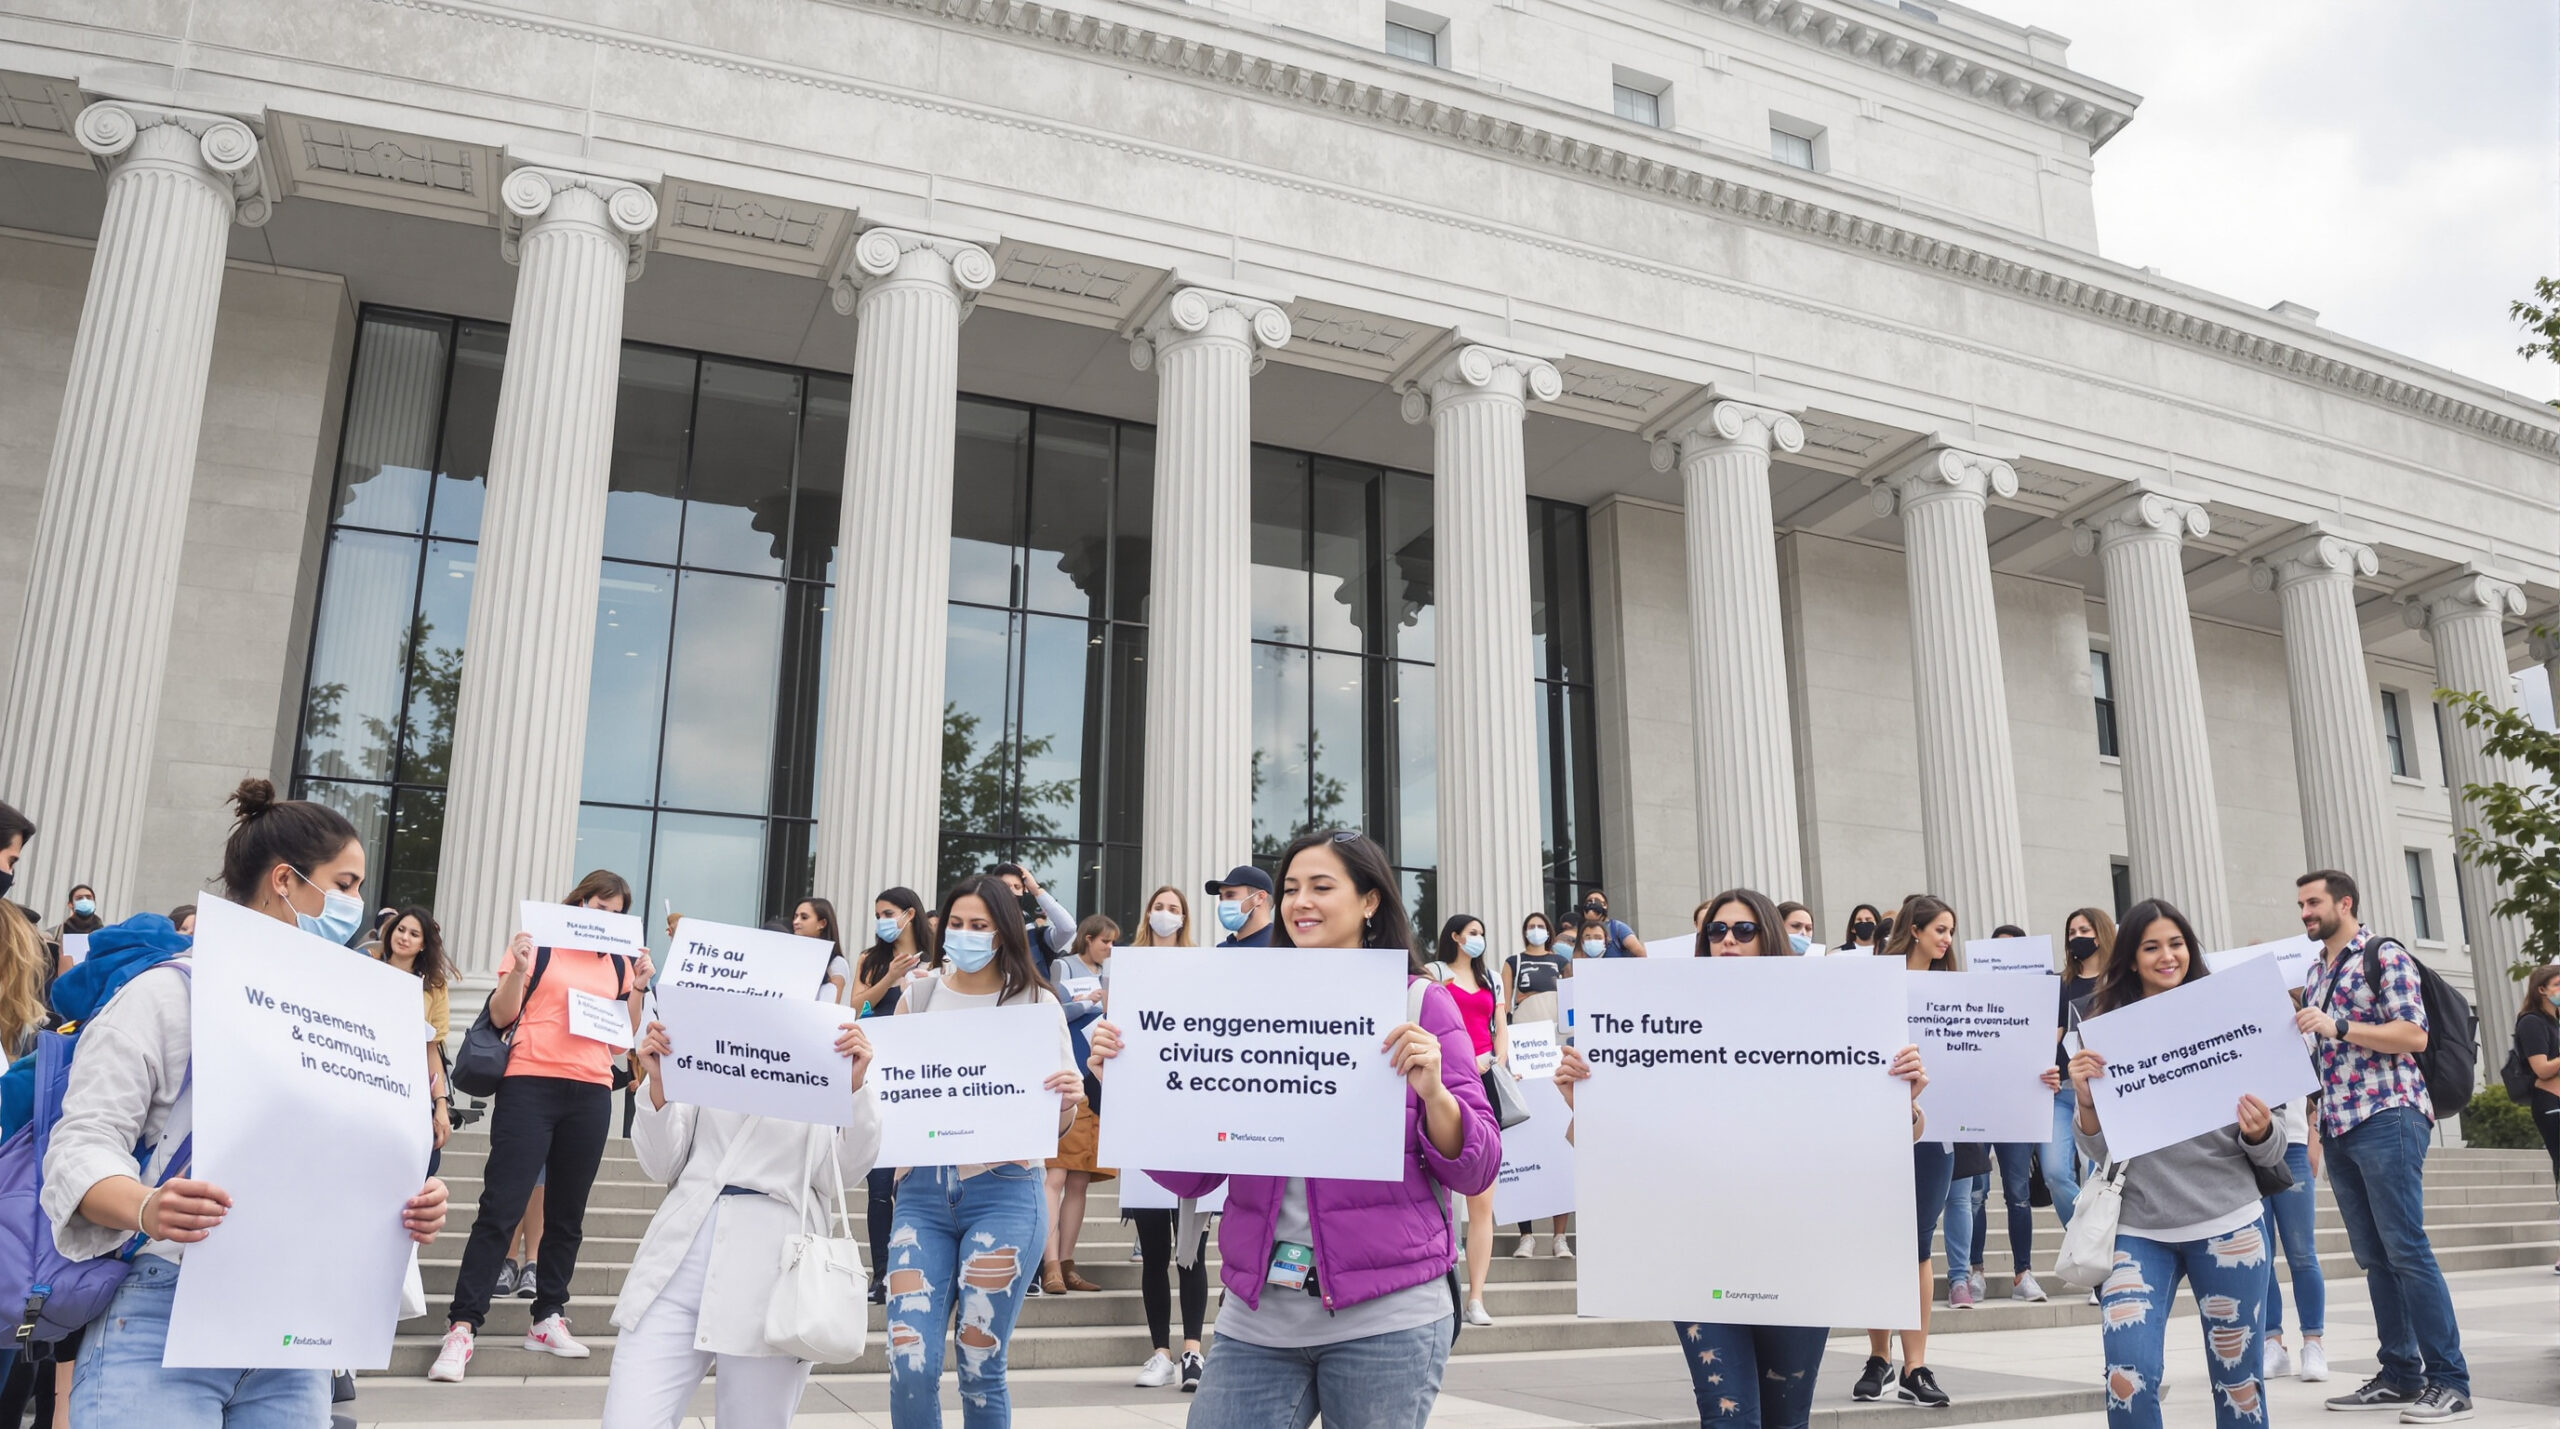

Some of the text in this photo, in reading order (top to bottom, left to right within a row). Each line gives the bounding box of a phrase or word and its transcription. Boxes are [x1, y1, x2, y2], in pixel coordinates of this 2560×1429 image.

[689, 942, 719, 958] This
[680, 959, 694, 972] is
[711, 966, 748, 980] your
[245, 986, 275, 1009] We
[1139, 1010, 1176, 1032] We
[1591, 1014, 1634, 1034] The
[292, 1025, 304, 1042] &
[301, 1052, 316, 1070] in
[1240, 1046, 1357, 1071] connique,
[1588, 1046, 1886, 1068] engagement ecvernomics.
[677, 1055, 693, 1069] of
[750, 1068, 829, 1087] ecmanics
[881, 1066, 915, 1081] The
[957, 1064, 986, 1077] our
[2108, 1063, 2135, 1078] The
[948, 1086, 958, 1097] a
[1166, 1071, 1337, 1095] & ecconomics
[2115, 1077, 2146, 1098] your
